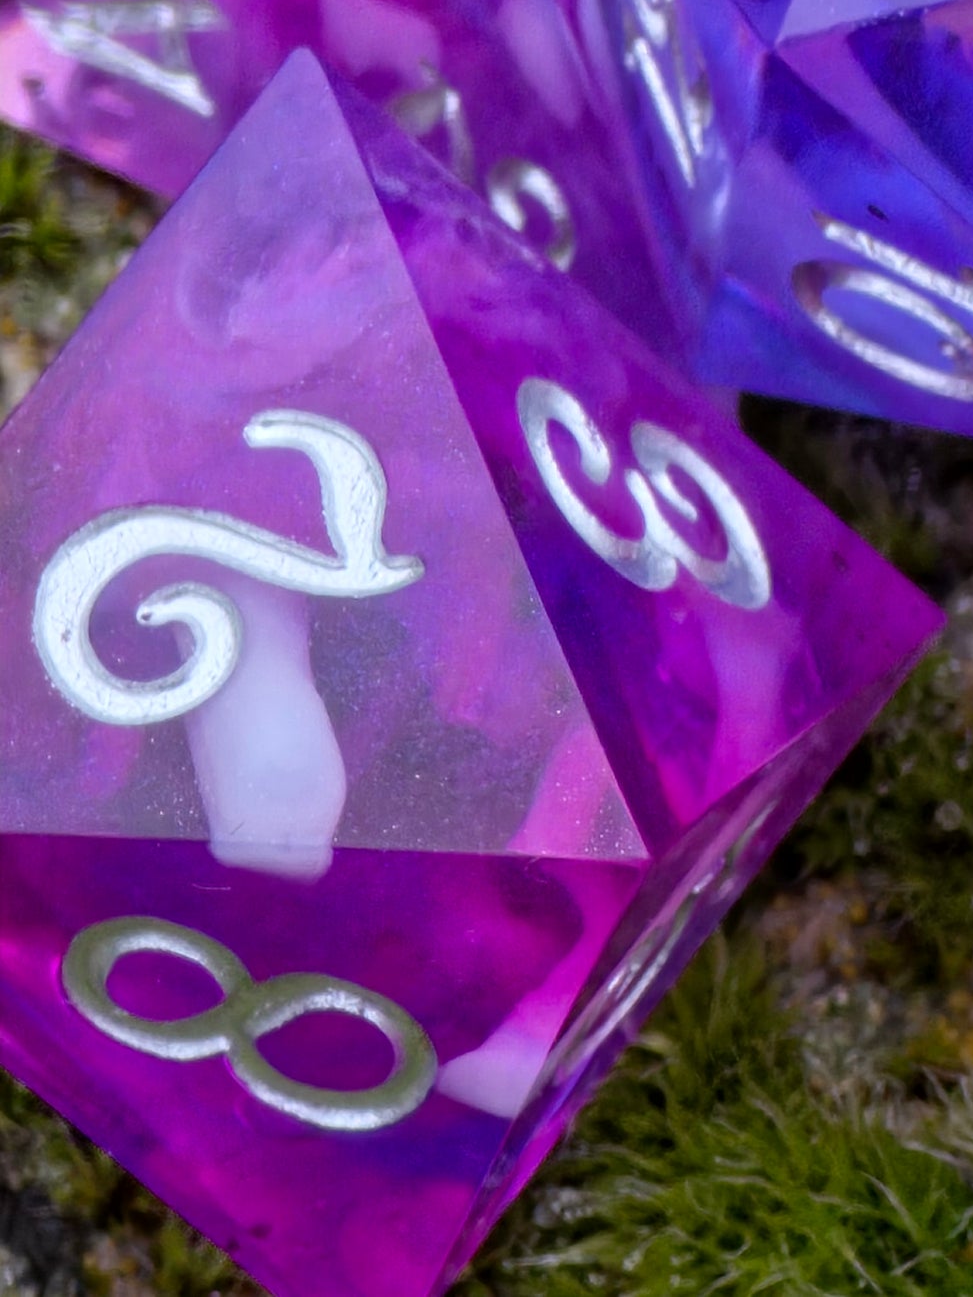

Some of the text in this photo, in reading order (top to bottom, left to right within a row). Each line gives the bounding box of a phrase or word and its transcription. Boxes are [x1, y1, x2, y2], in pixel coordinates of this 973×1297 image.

[33, 408, 425, 726] 2
[516, 376, 772, 610] 3
[61, 914, 438, 1132] 8
